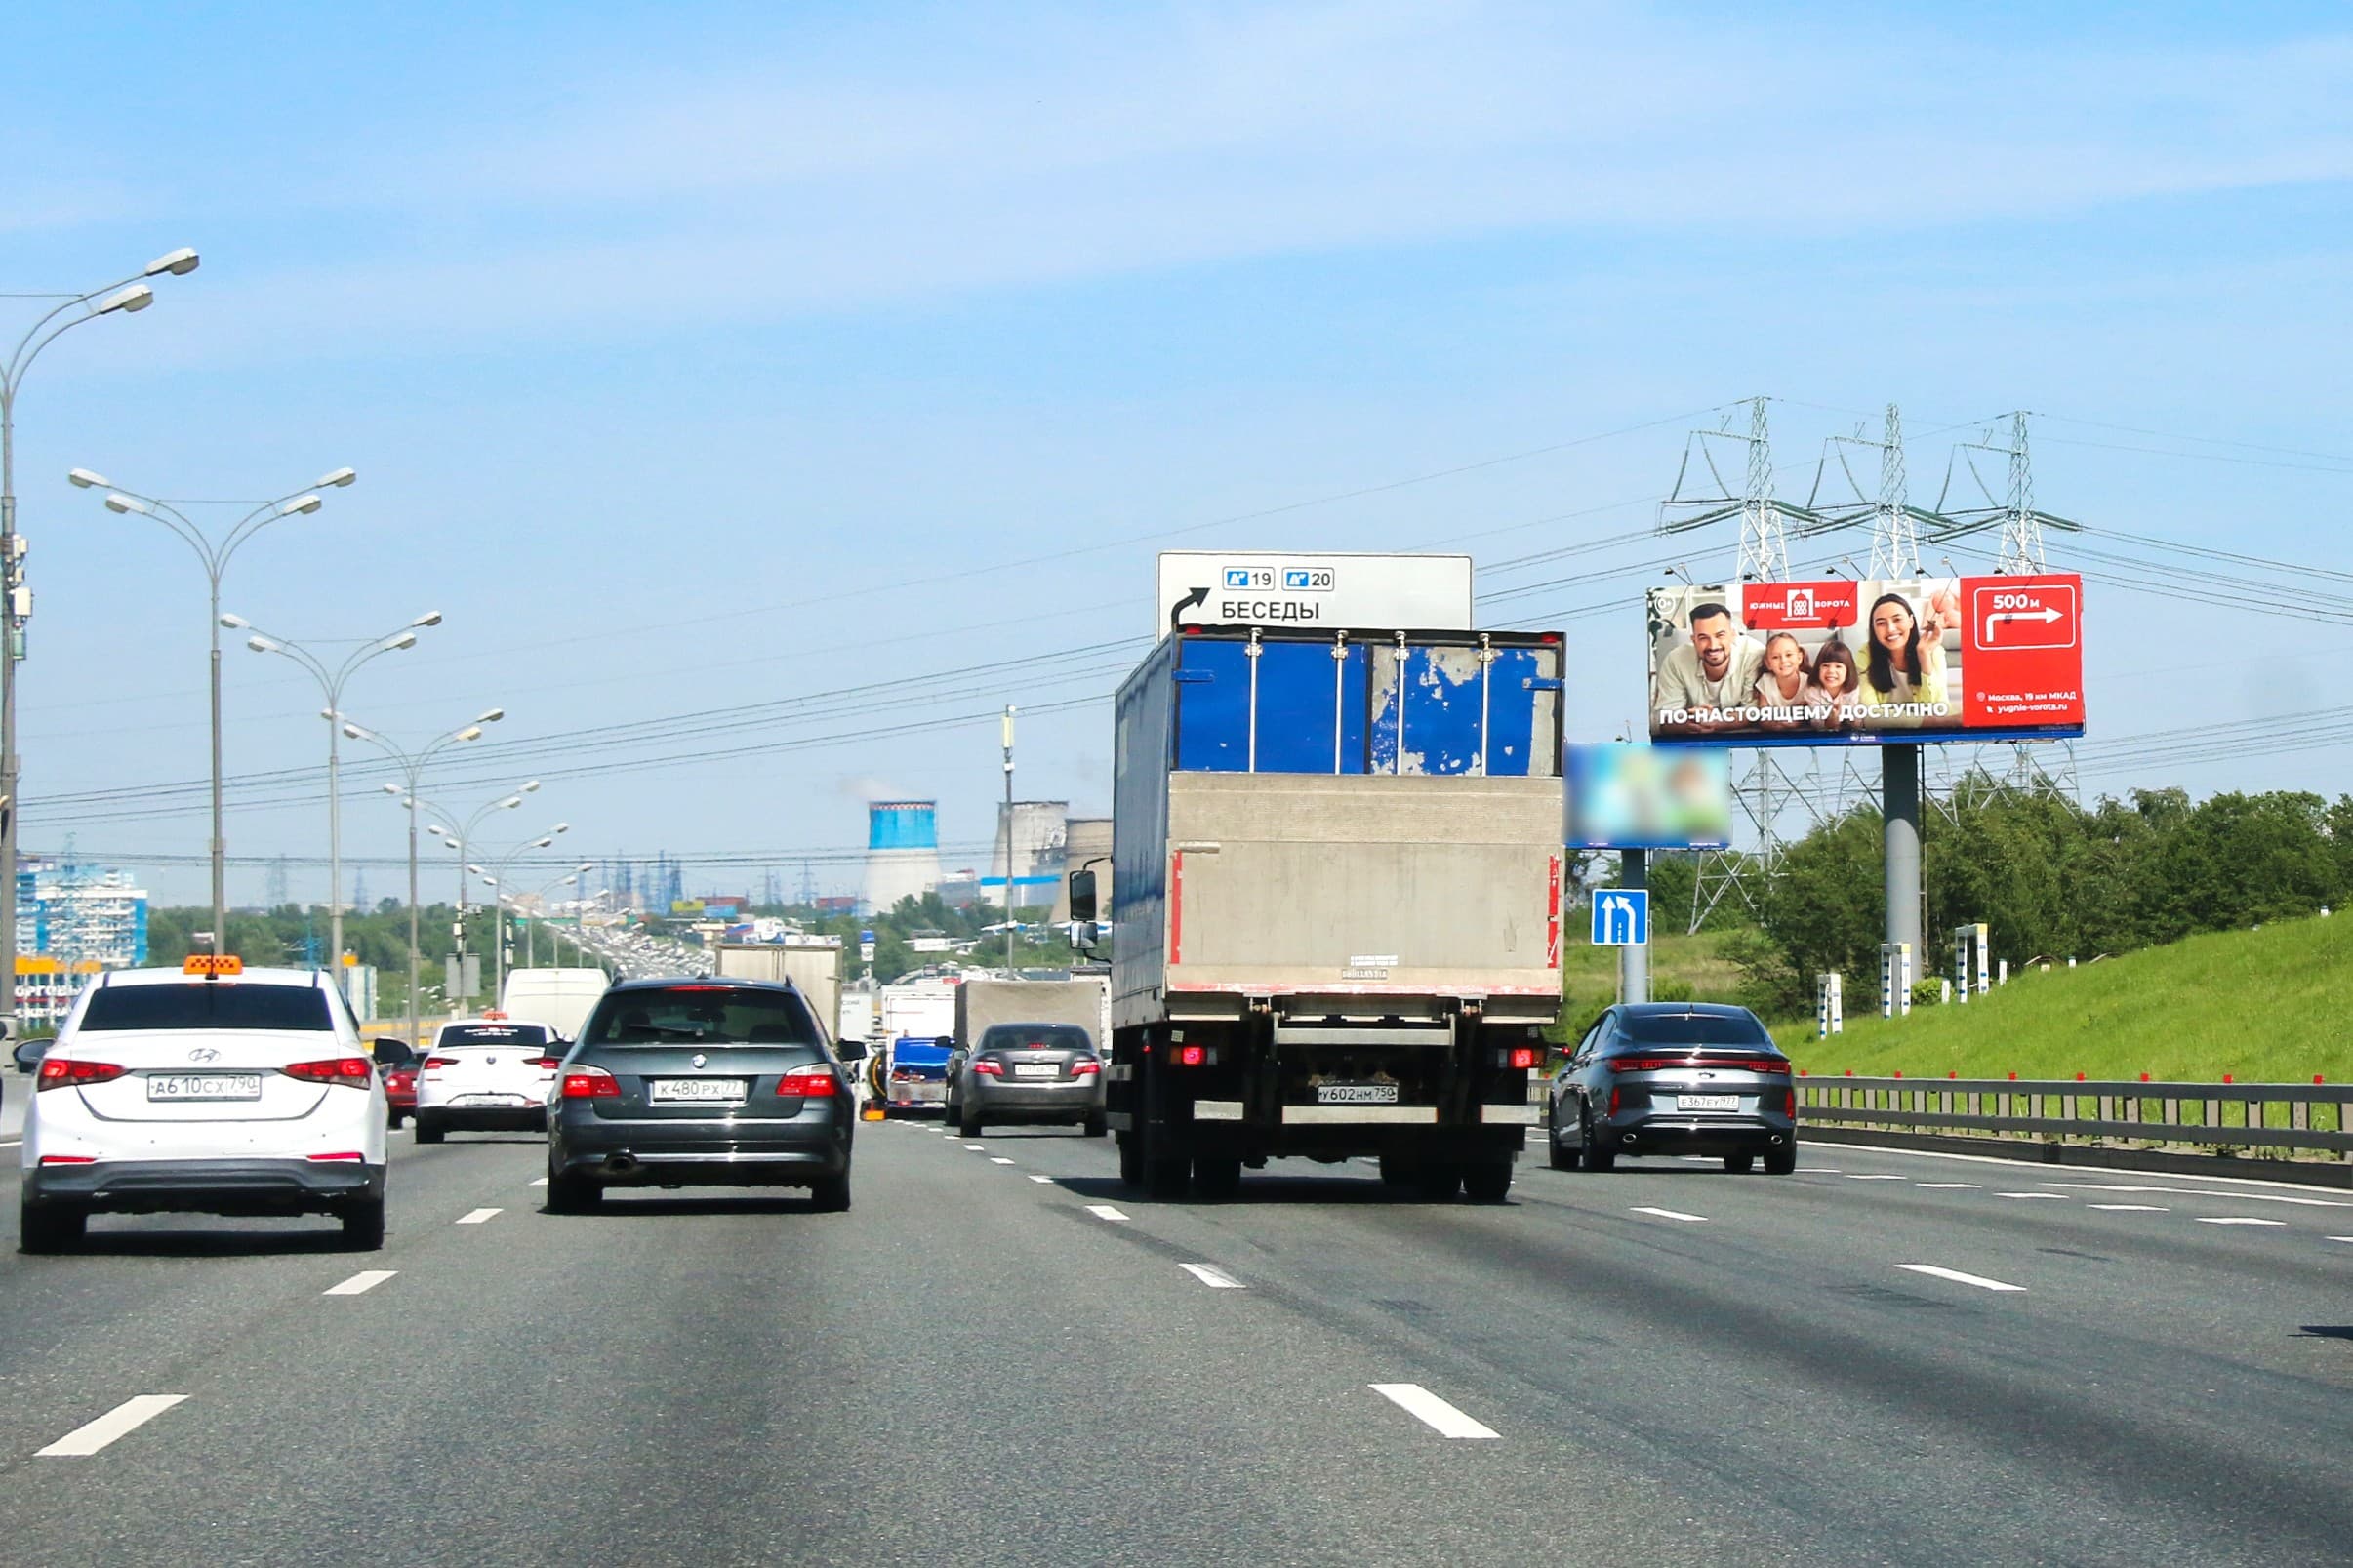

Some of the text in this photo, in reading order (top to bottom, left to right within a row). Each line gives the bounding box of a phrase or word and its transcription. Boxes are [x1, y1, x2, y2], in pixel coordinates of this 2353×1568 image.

[1252, 571, 1272, 585] 19
[1312, 572, 1331, 586] 20
[1815, 599, 1850, 608] ВОРОТА
[1993, 594, 2028, 609] 500
[1222, 601, 1319, 620] БЕСЕДЫ
[2024, 692, 2034, 701] 19
[2049, 691, 2077, 700] МКАД
[1659, 702, 1948, 724] ПО-НАСТОЯЩЕМУ ДОСТУПНО
[156, 1077, 224, 1094] А610СХ
[1323, 1089, 1371, 1100] У602НМ
